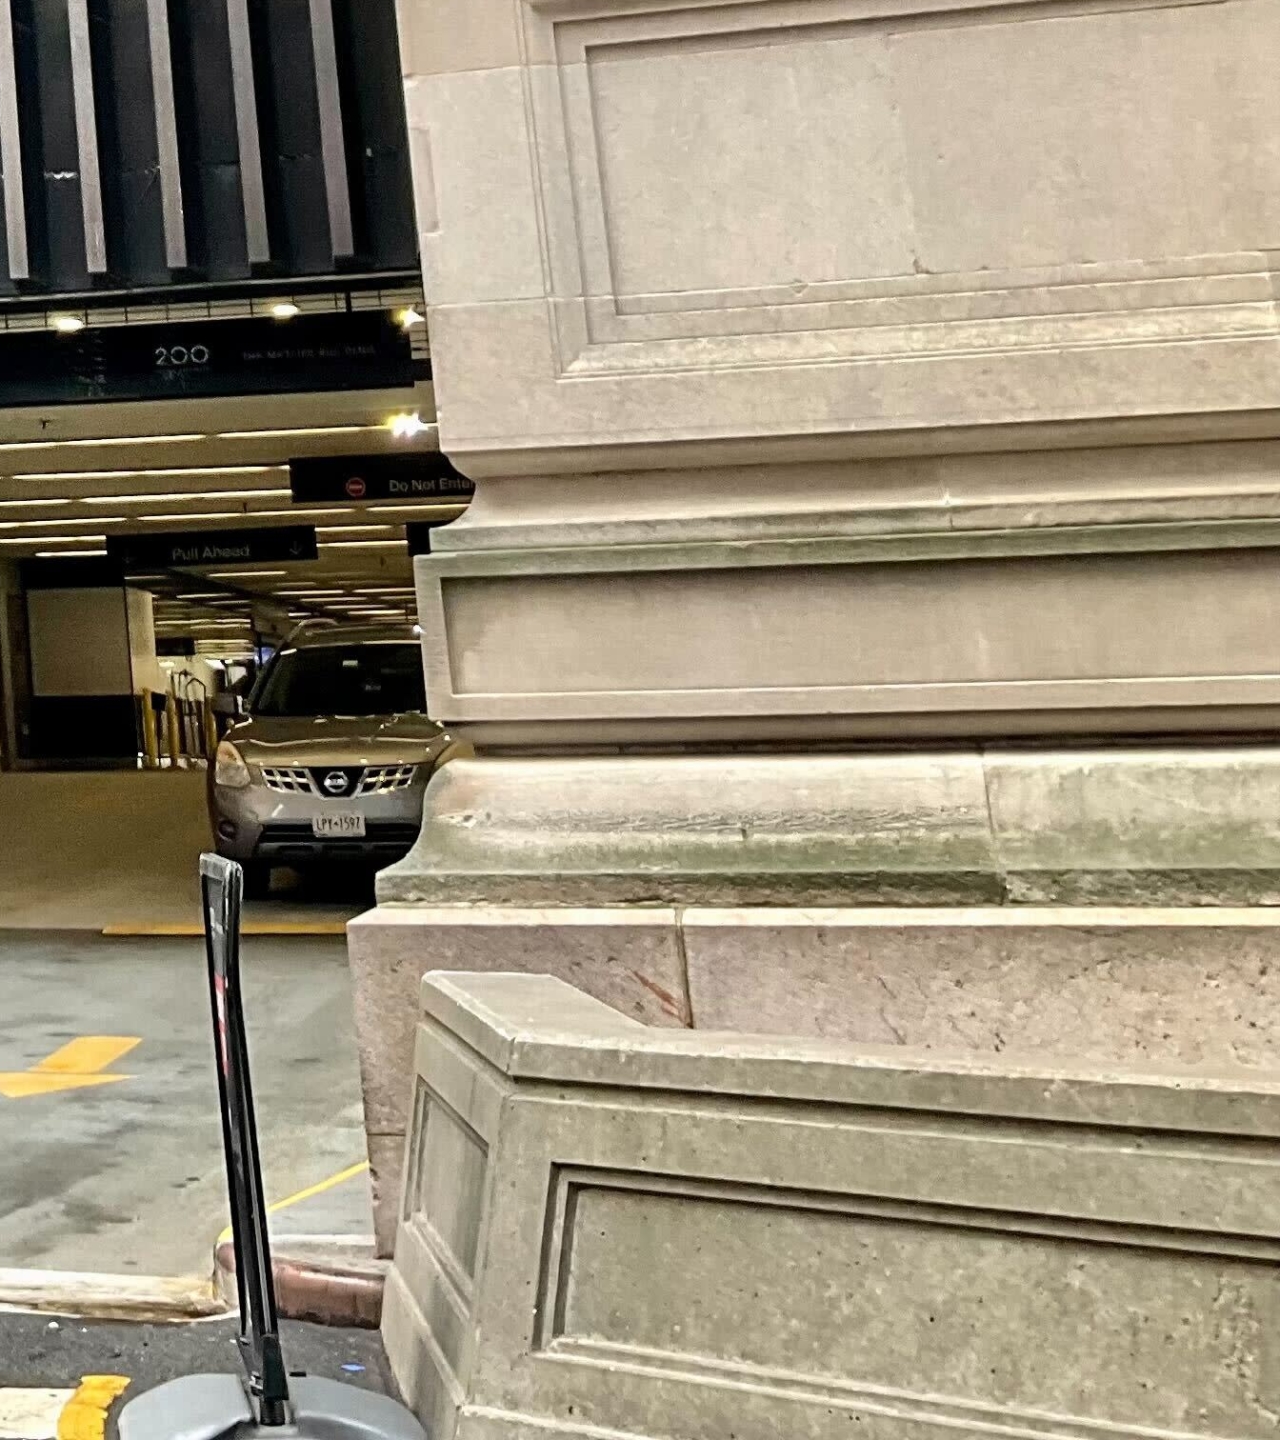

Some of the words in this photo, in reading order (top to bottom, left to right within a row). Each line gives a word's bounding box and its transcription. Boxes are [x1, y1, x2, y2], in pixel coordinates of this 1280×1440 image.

[154, 344, 210, 366] 200
[388, 478, 409, 493] Do
[411, 478, 436, 492] Not
[171, 545, 199, 561] Pull
[202, 543, 251, 558] Ahead
